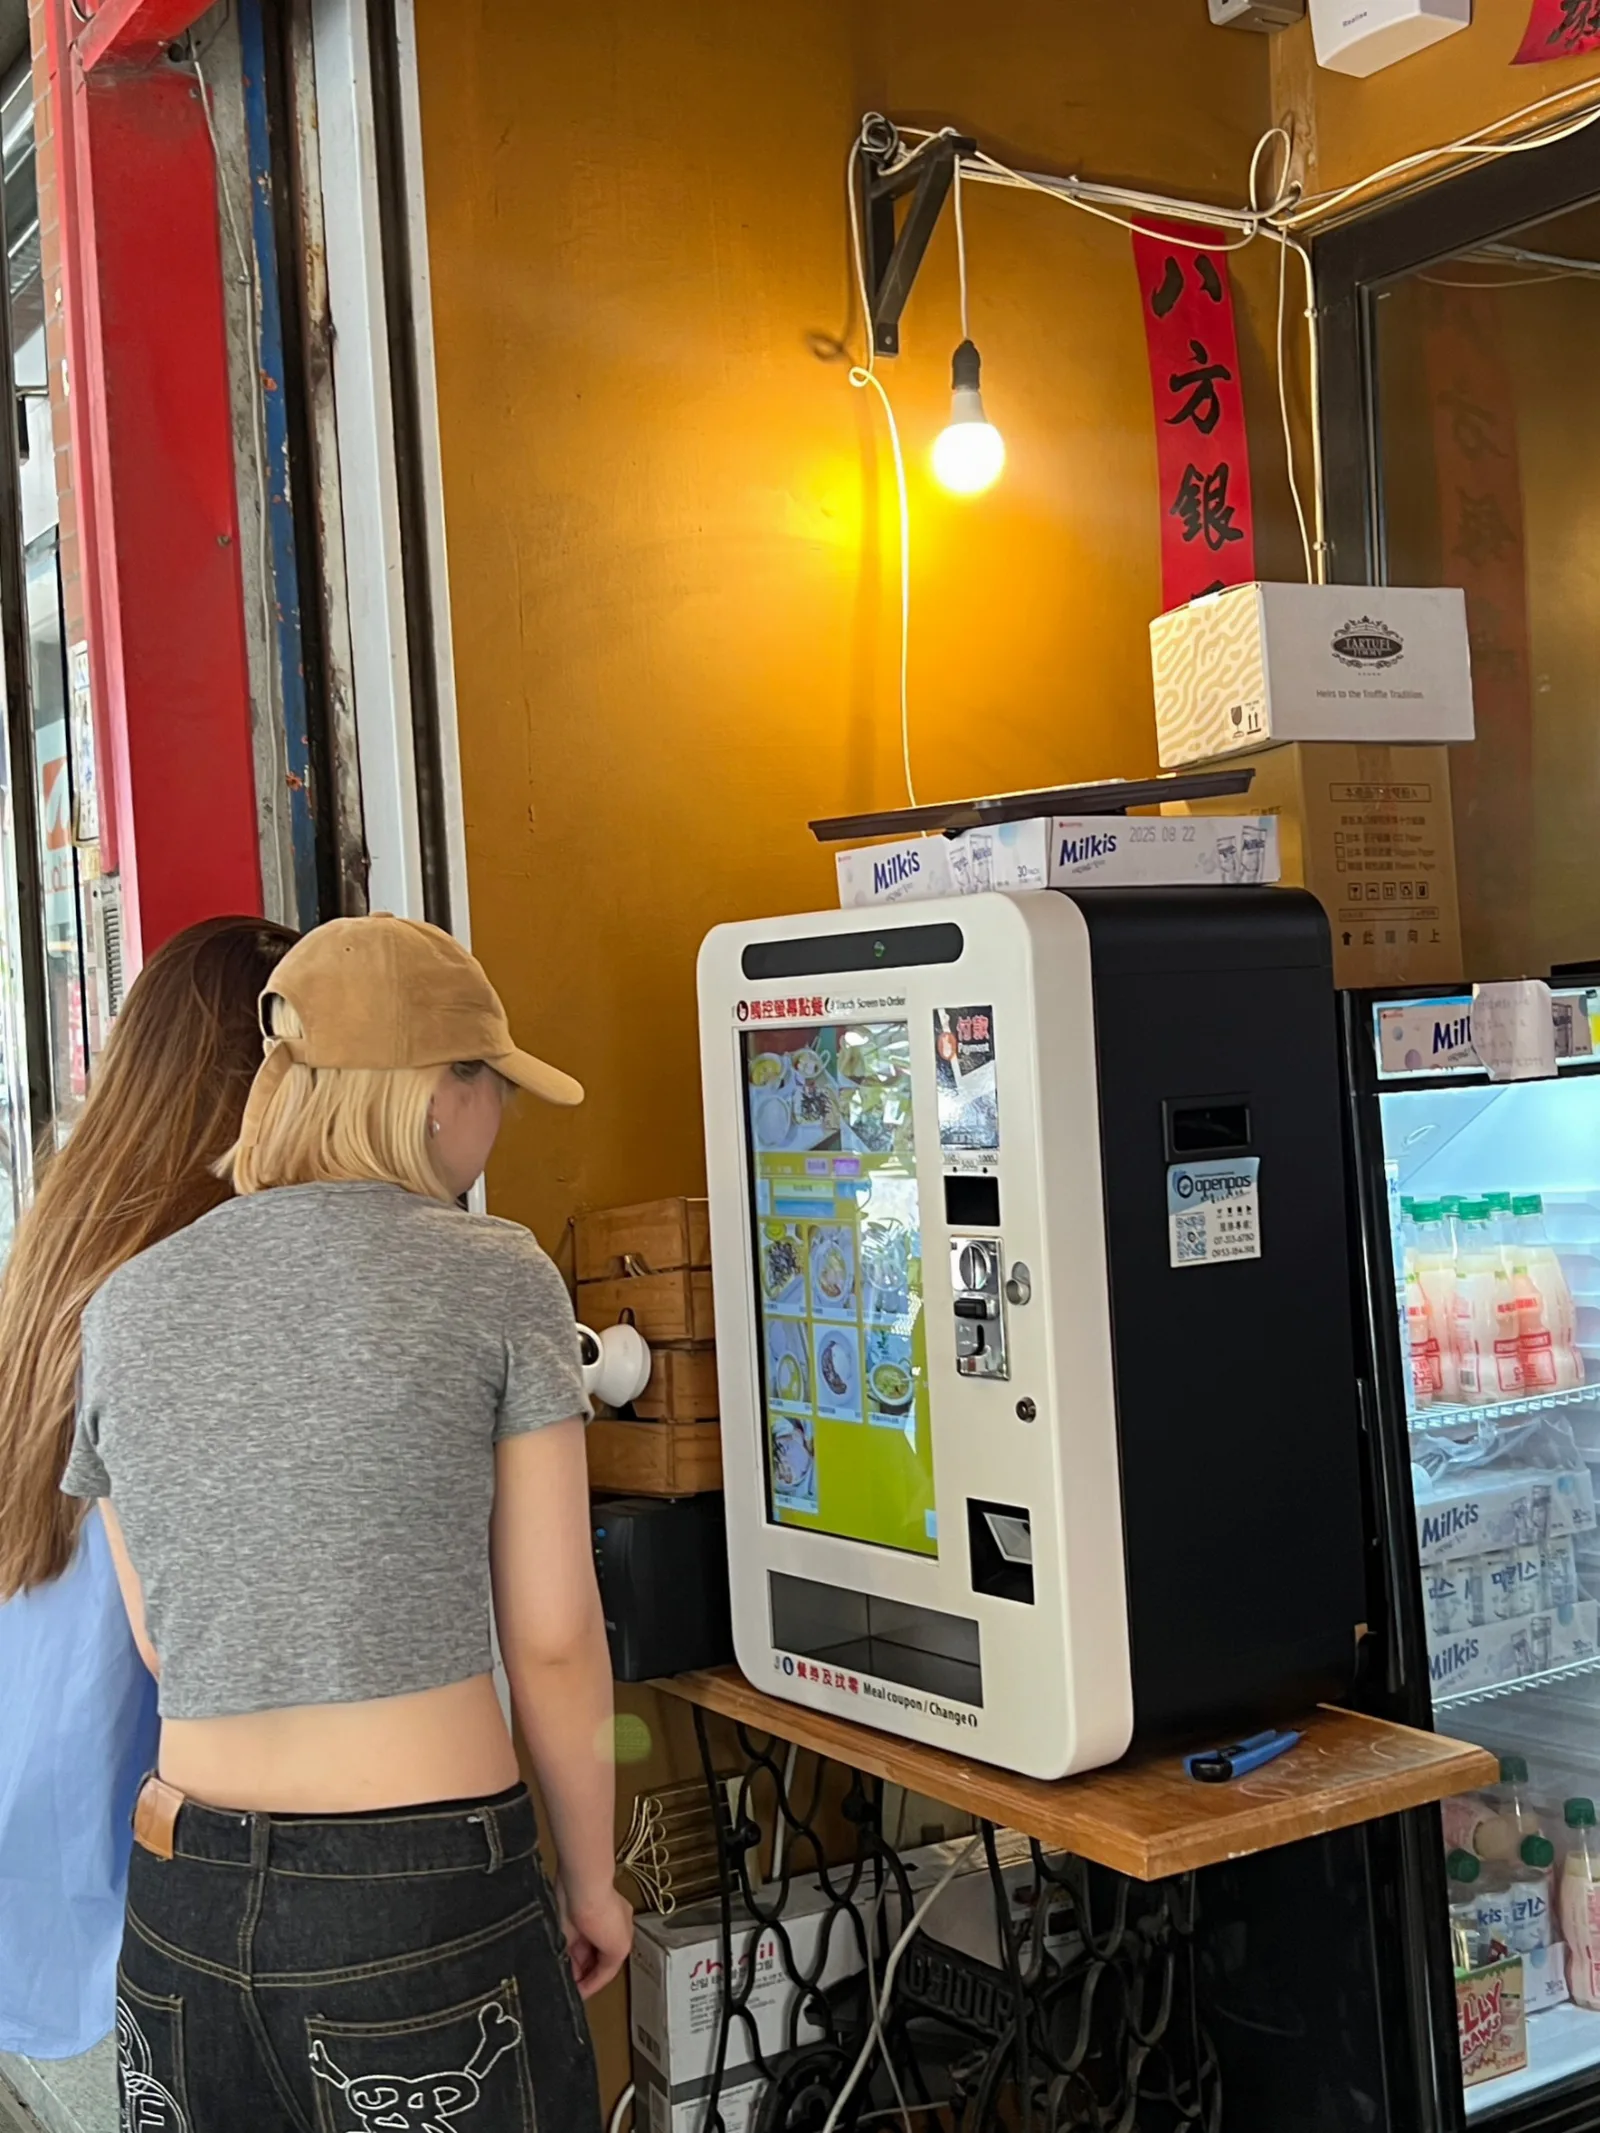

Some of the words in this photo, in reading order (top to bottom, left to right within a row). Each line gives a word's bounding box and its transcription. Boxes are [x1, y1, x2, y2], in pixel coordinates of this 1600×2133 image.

[1151, 255, 1244, 600] 八方銀
[1059, 833, 1117, 867] Milkis
[1130, 826, 1156, 842] 2025
[1182, 825, 1196, 842] 22
[873, 850, 921, 894] Milkis
[956, 1015, 990, 1041] 付款
[1195, 1174, 1251, 1198] openpos
[1422, 1503, 1479, 1548] Milkis
[1428, 1639, 1479, 1681] Milkis
[863, 1681, 885, 1700] Meal
[887, 1691, 922, 1711] coupon
[929, 1702, 967, 1726] Change
